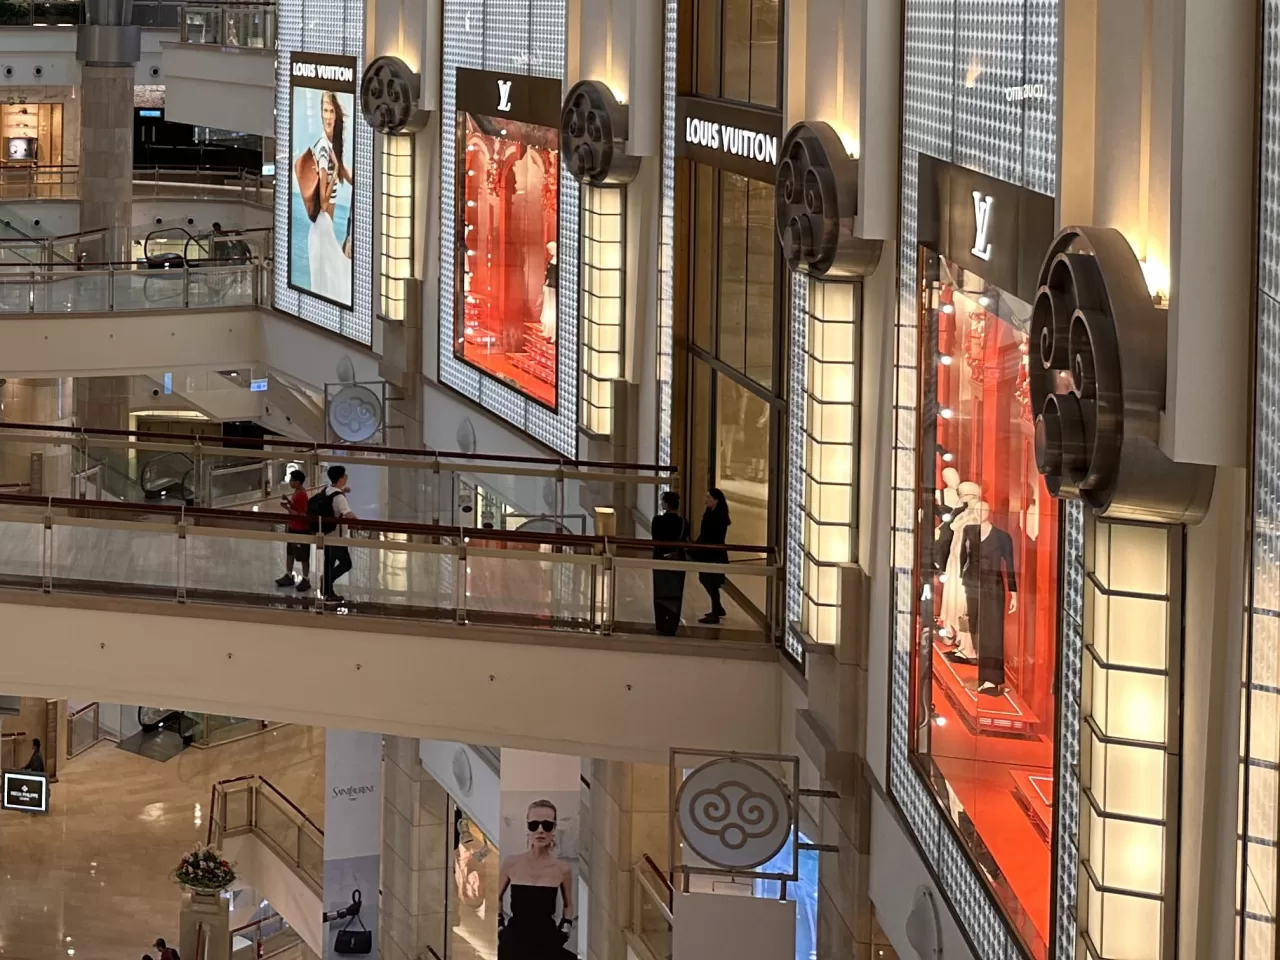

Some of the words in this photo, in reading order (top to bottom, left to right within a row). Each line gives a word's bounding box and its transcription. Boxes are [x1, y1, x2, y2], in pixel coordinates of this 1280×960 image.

[292, 62, 316, 78] LOUIS
[316, 65, 353, 82] VUITTON
[686, 117, 719, 150] LOUIS
[721, 125, 777, 165] VUITTON
